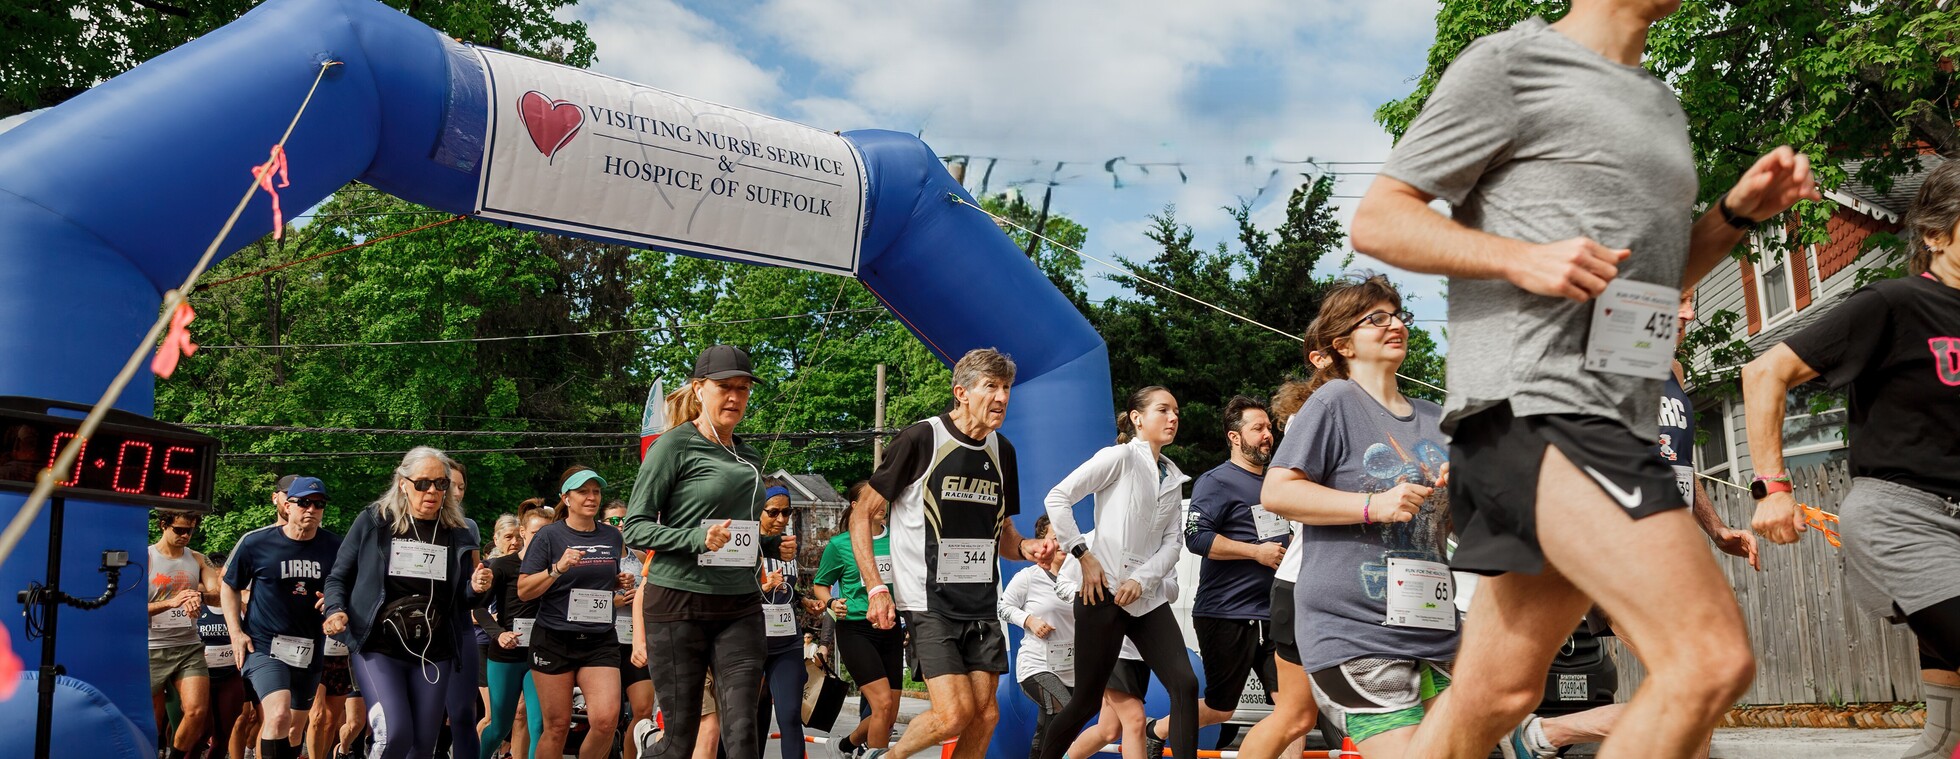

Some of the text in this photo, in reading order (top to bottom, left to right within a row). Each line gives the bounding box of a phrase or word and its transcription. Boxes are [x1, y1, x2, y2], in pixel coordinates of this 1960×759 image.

[588, 104, 845, 176] VISITING NURSE SERVICE
[717, 154, 736, 173] &
[604, 155, 833, 217] HOSPICE OF SUFFOLK
[941, 475, 1000, 496] GLIRC
[945, 491, 997, 502] RACING TEAM
[735, 533, 751, 547] 80
[423, 552, 436, 564] 77
[963, 551, 987, 564] 344
[280, 559, 322, 580] LIRRC
[1435, 582, 1448, 601] 65
[592, 598, 608, 610] 367
[780, 612, 792, 622] 128
[219, 650, 234, 658] 469
[296, 645, 311, 656] 177
